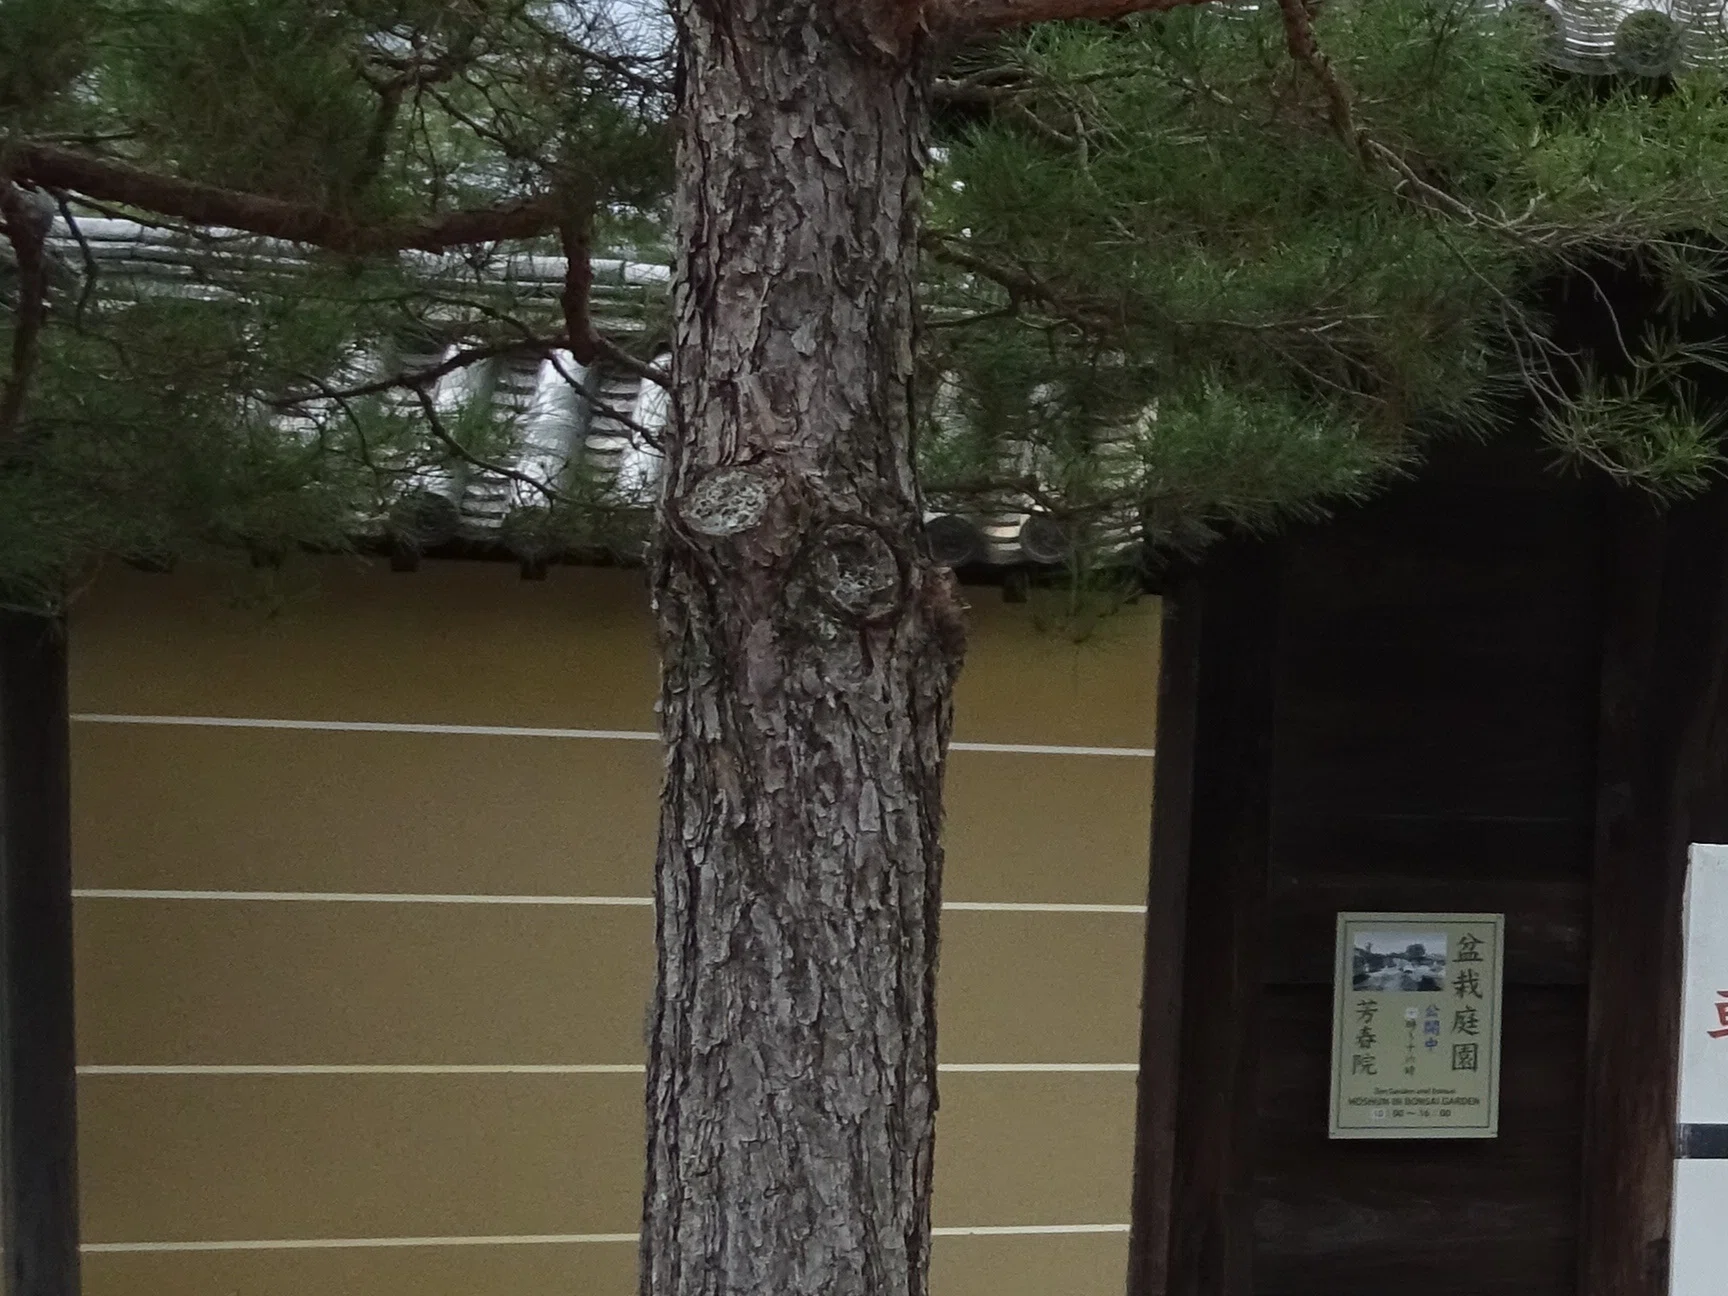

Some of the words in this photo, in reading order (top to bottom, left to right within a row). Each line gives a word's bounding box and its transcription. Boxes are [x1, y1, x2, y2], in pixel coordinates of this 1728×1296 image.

[1352, 999, 1378, 1075] 芳春院
[1424, 1004, 1440, 1051] 公開中
[1451, 933, 1485, 1073] 盆栽庭園
